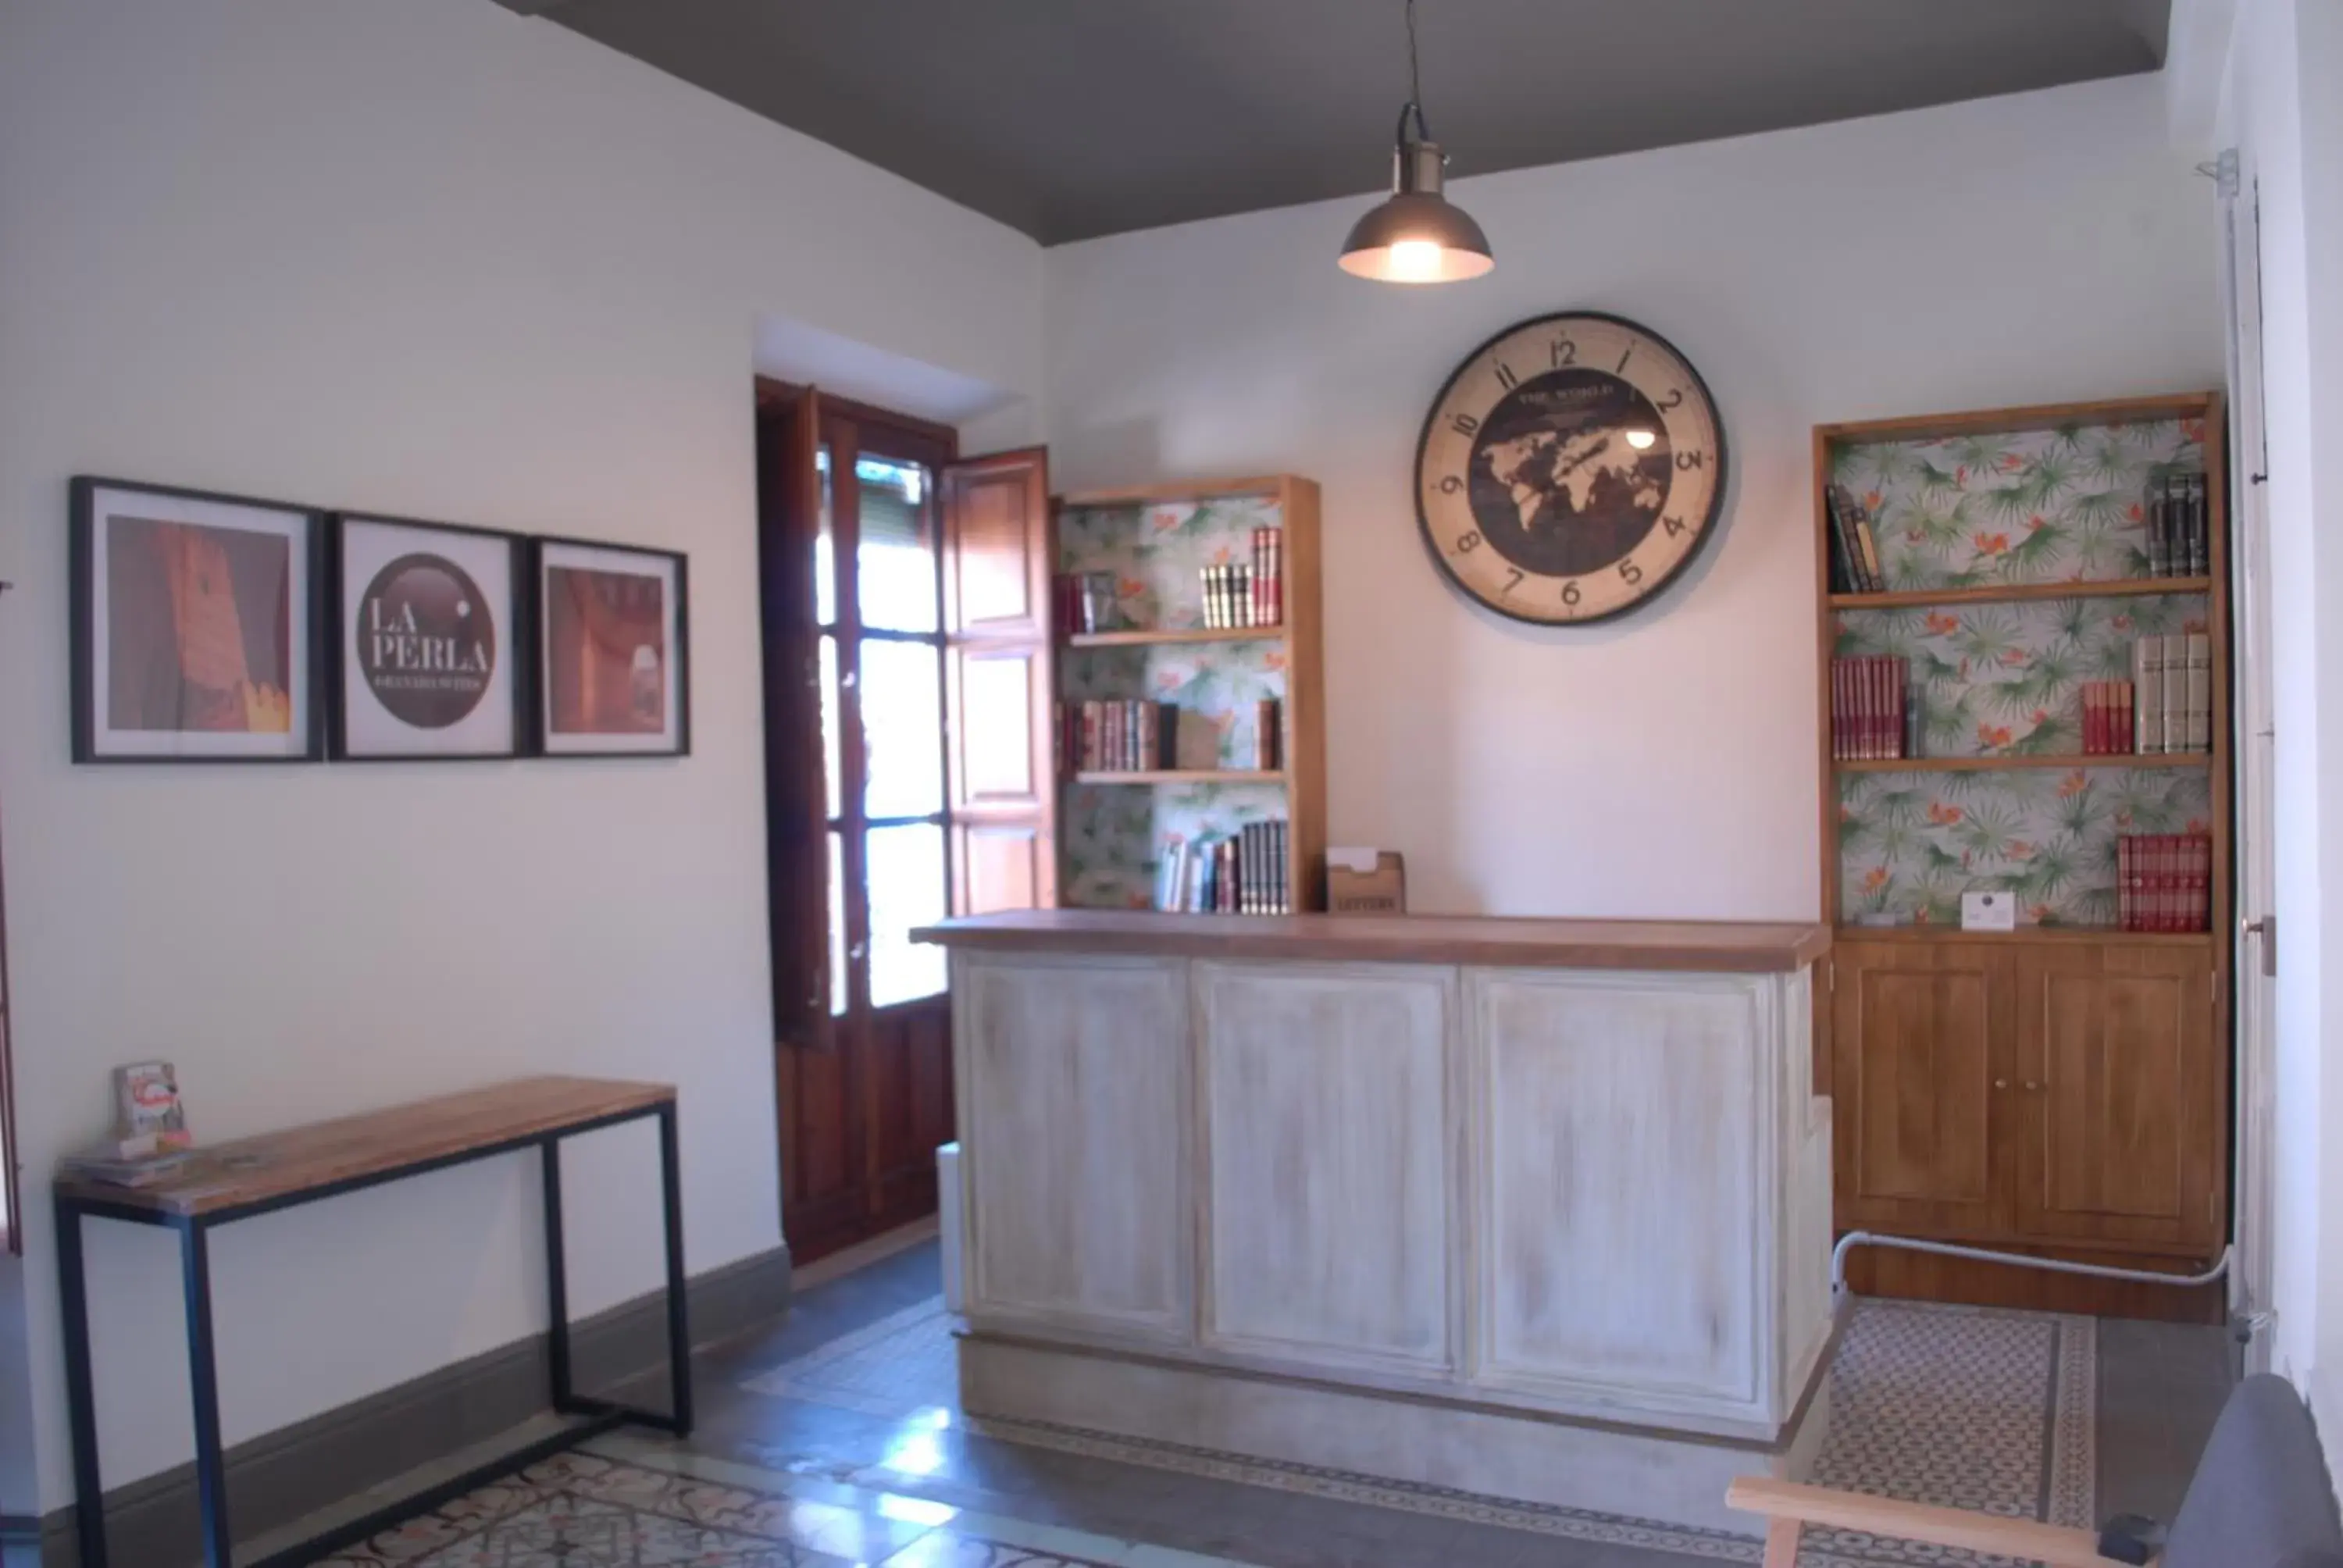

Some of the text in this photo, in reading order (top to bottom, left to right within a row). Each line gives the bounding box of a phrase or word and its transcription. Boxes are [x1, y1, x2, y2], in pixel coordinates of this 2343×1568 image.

[1550, 340, 1576, 367] 12
[1615, 350, 1631, 373] 1
[1494, 363, 1518, 390] 11
[1555, 383, 1614, 401] WORLD
[1656, 389, 1683, 415] 2
[1452, 413, 1479, 439] 10
[1676, 450, 1703, 471] 3
[1440, 476, 1464, 495] 9
[1662, 515, 1687, 539] 4
[1457, 529, 1482, 553] 8
[1501, 567, 1525, 593] 7
[1618, 560, 1643, 586] 5
[1561, 580, 1581, 606] 6
[371, 597, 417, 634] LA
[372, 634, 487, 672] PERLA
